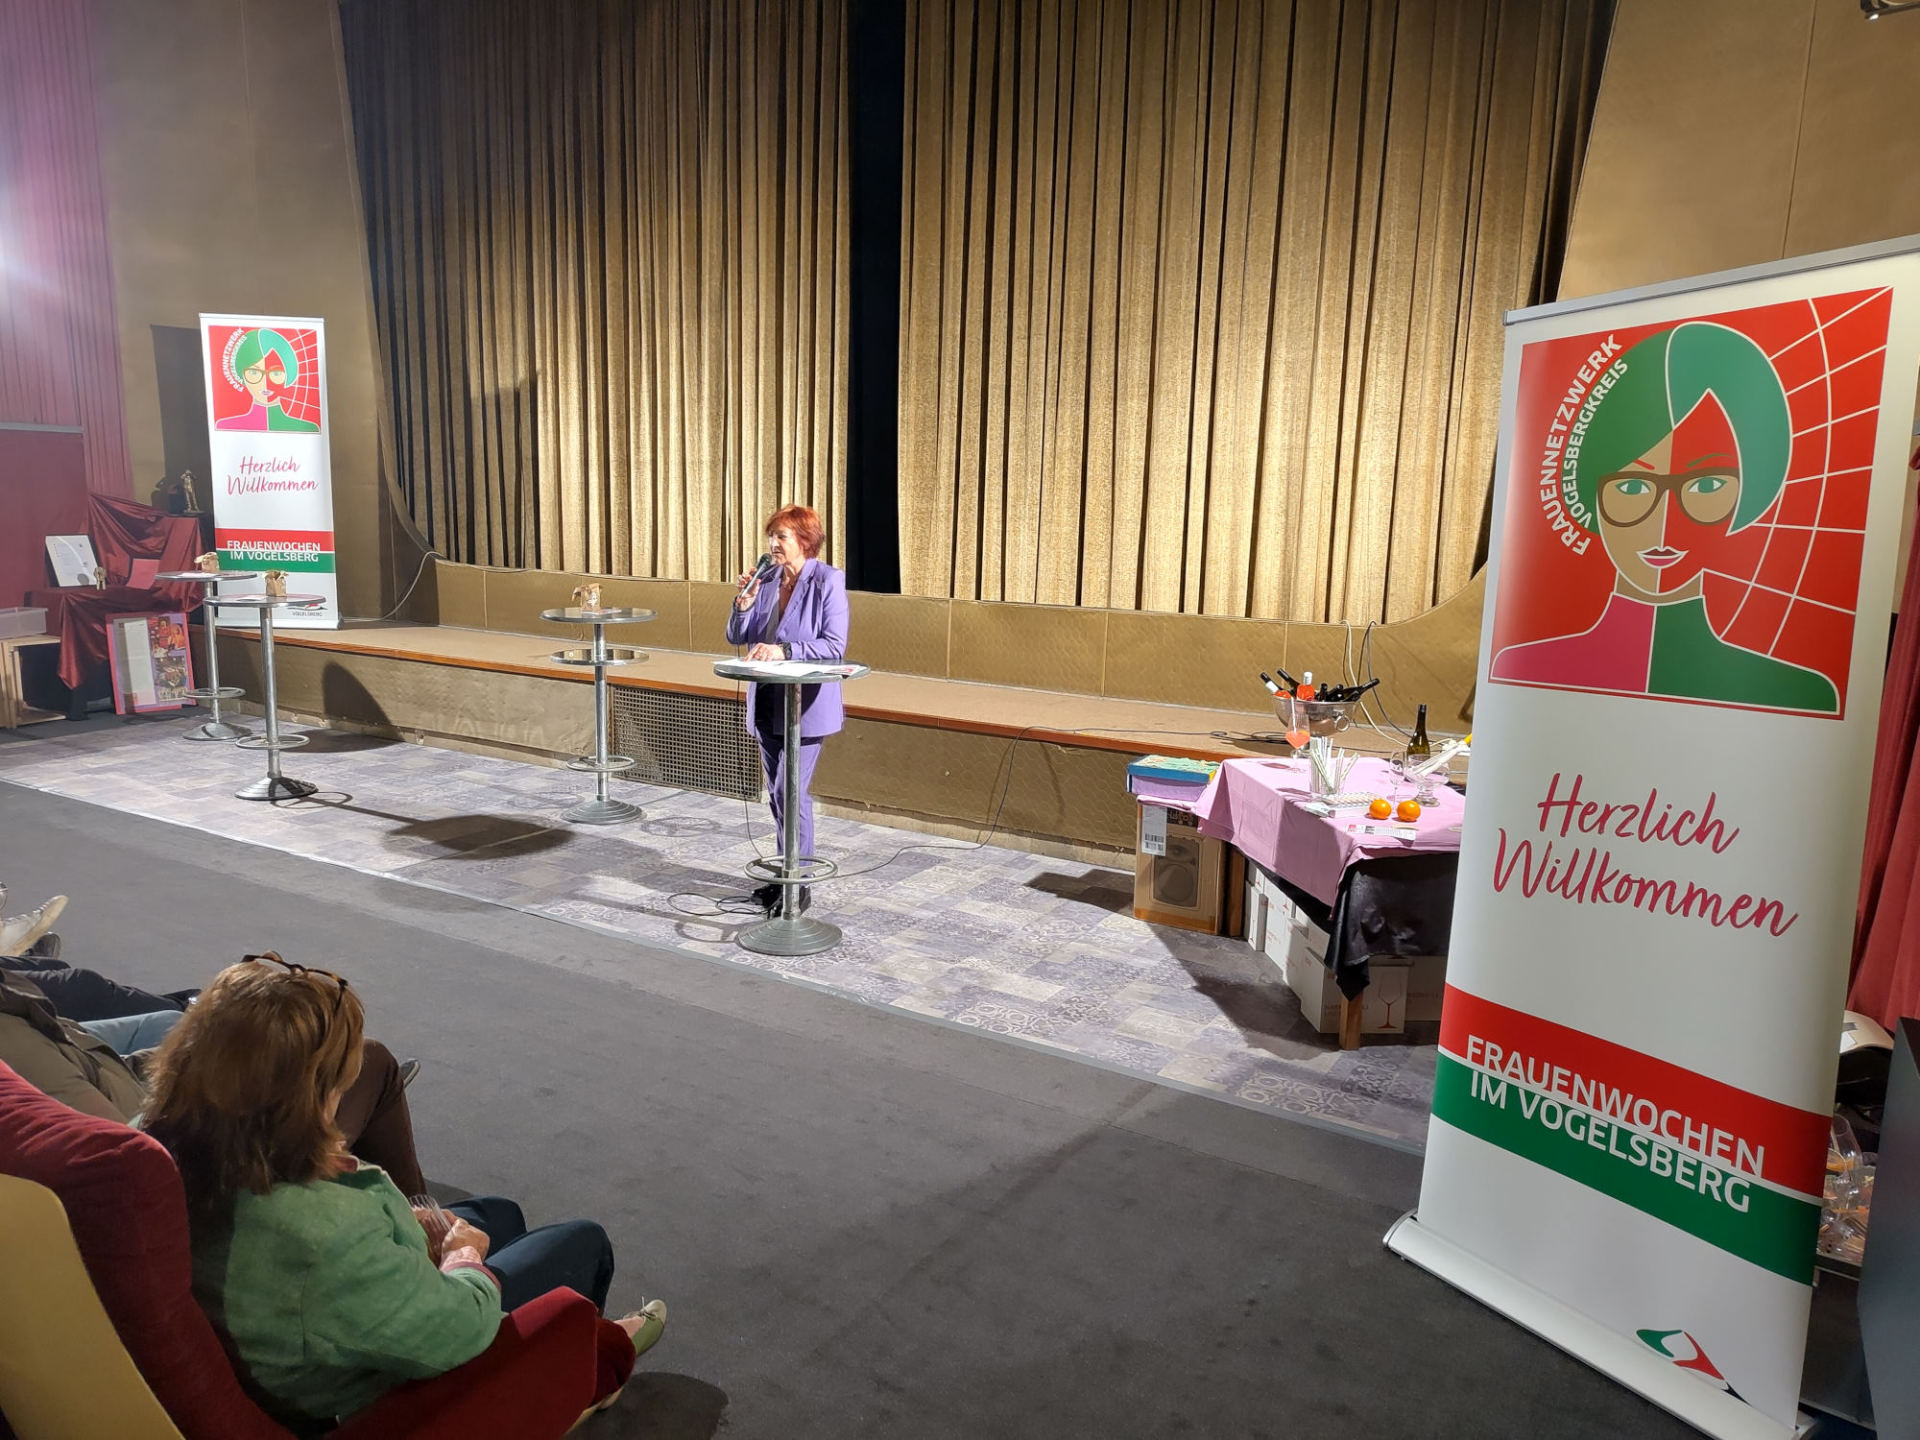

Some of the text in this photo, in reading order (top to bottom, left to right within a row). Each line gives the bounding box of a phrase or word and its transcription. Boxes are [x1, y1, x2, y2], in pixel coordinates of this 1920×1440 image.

[227, 474, 319, 495] Willkommen
[240, 455, 301, 475] Herzlich
[1540, 334, 1622, 555] FRAUENNETZWERK
[1562, 358, 1628, 529] VOGELSBERGKREIS
[226, 540, 321, 552] FRAUENWOCHEN
[230, 550, 320, 563] IM VOGELSBERG
[1537, 773, 1740, 854] Herzlich
[1493, 827, 1799, 937] Willkommen
[1466, 1034, 1765, 1179] FRAUENWOCHEN
[1470, 1069, 1751, 1214] IM VOGELSBERG
